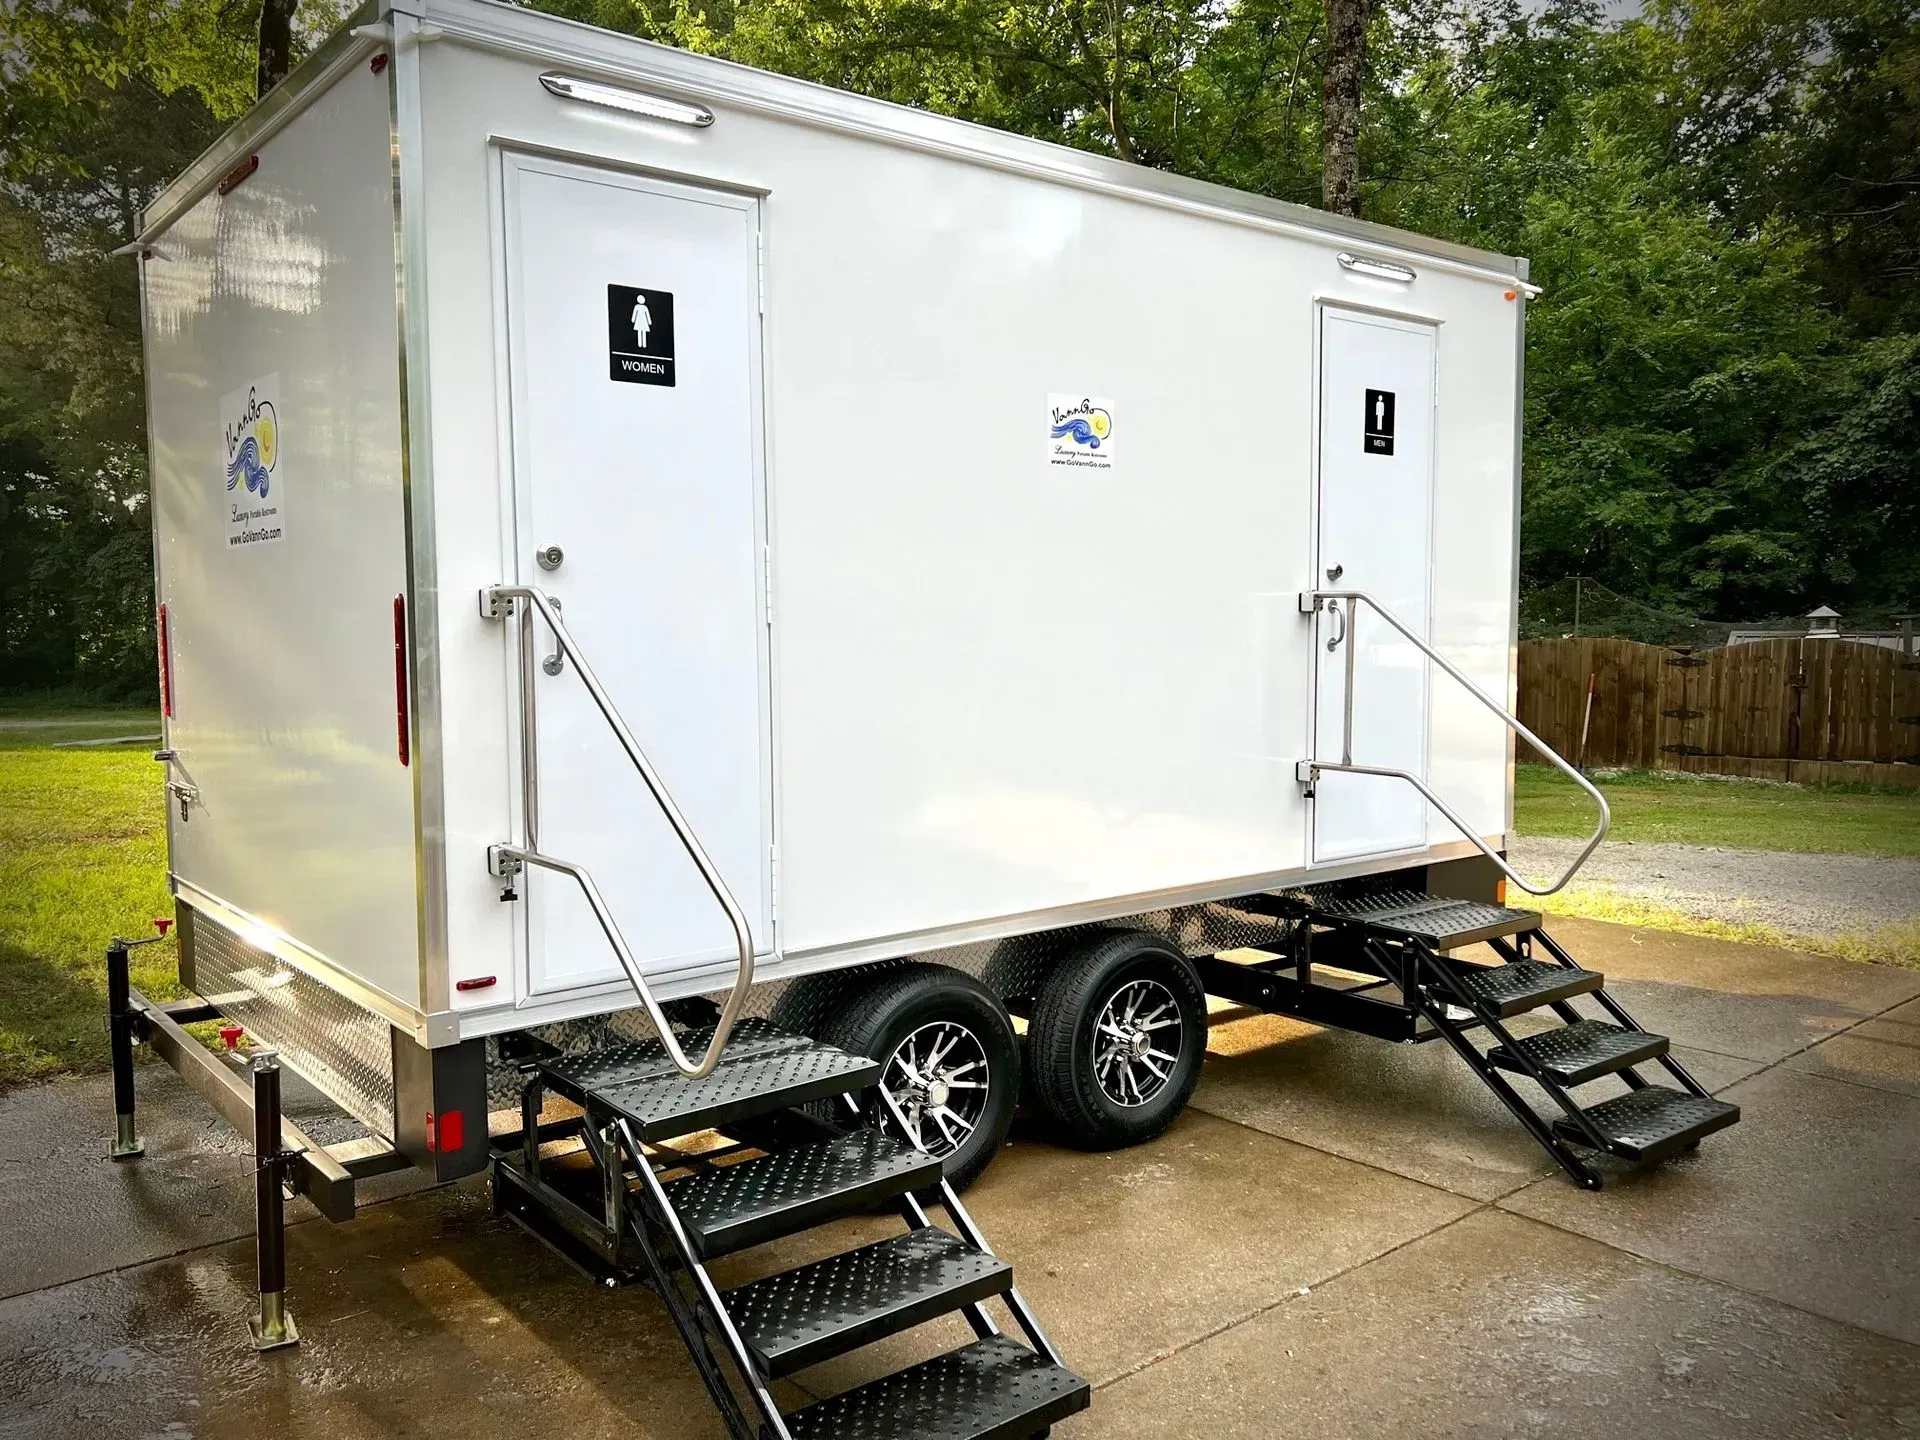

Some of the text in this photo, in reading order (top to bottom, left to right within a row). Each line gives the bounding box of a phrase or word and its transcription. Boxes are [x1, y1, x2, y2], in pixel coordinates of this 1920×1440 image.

[621, 360, 665, 374] WOMEN
[1052, 398, 1095, 424] VannGo
[226, 386, 262, 458] VannGo
[1373, 439, 1386, 447] MEN
[1051, 459, 1111, 468] www.GoVannGo.com
[230, 528, 282, 545] www.GoVannGo.com
